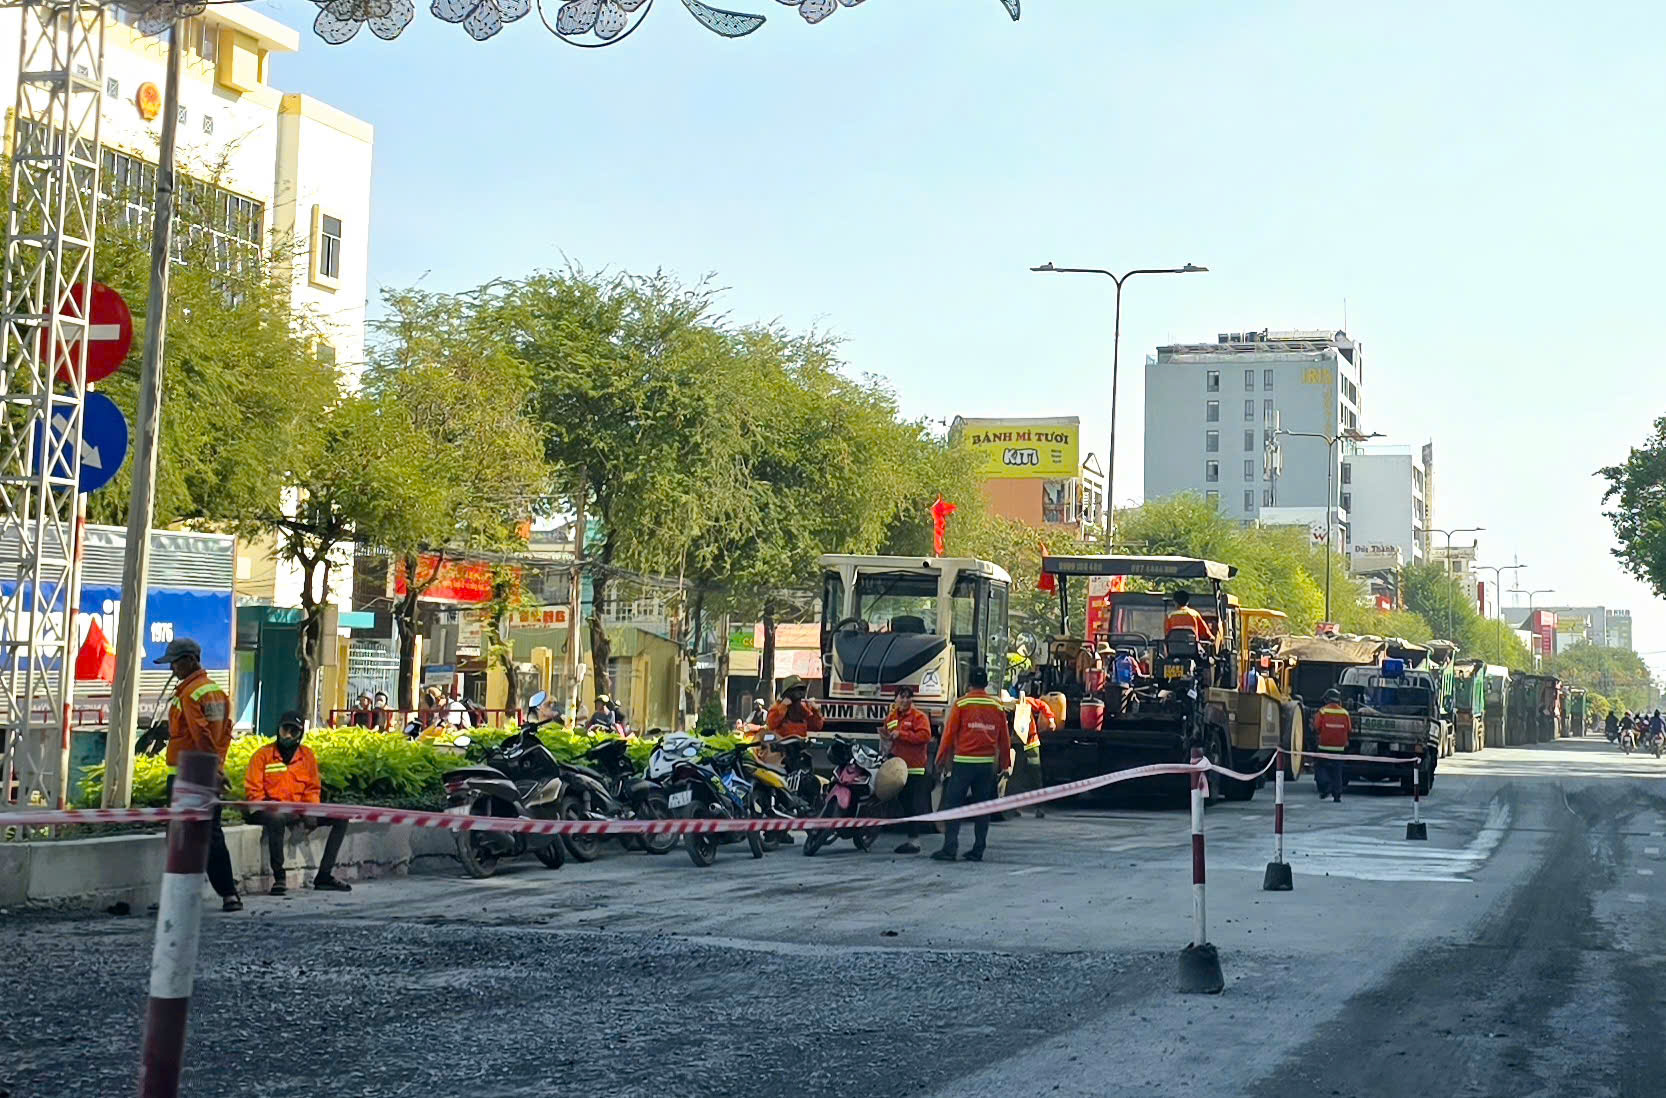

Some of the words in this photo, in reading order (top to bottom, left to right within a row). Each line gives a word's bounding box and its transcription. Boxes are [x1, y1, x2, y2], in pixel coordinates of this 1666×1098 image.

[972, 430, 1013, 445] BÁNH
[1035, 431, 1069, 445] TƯƠI
[1002, 447, 1040, 466] KITI
